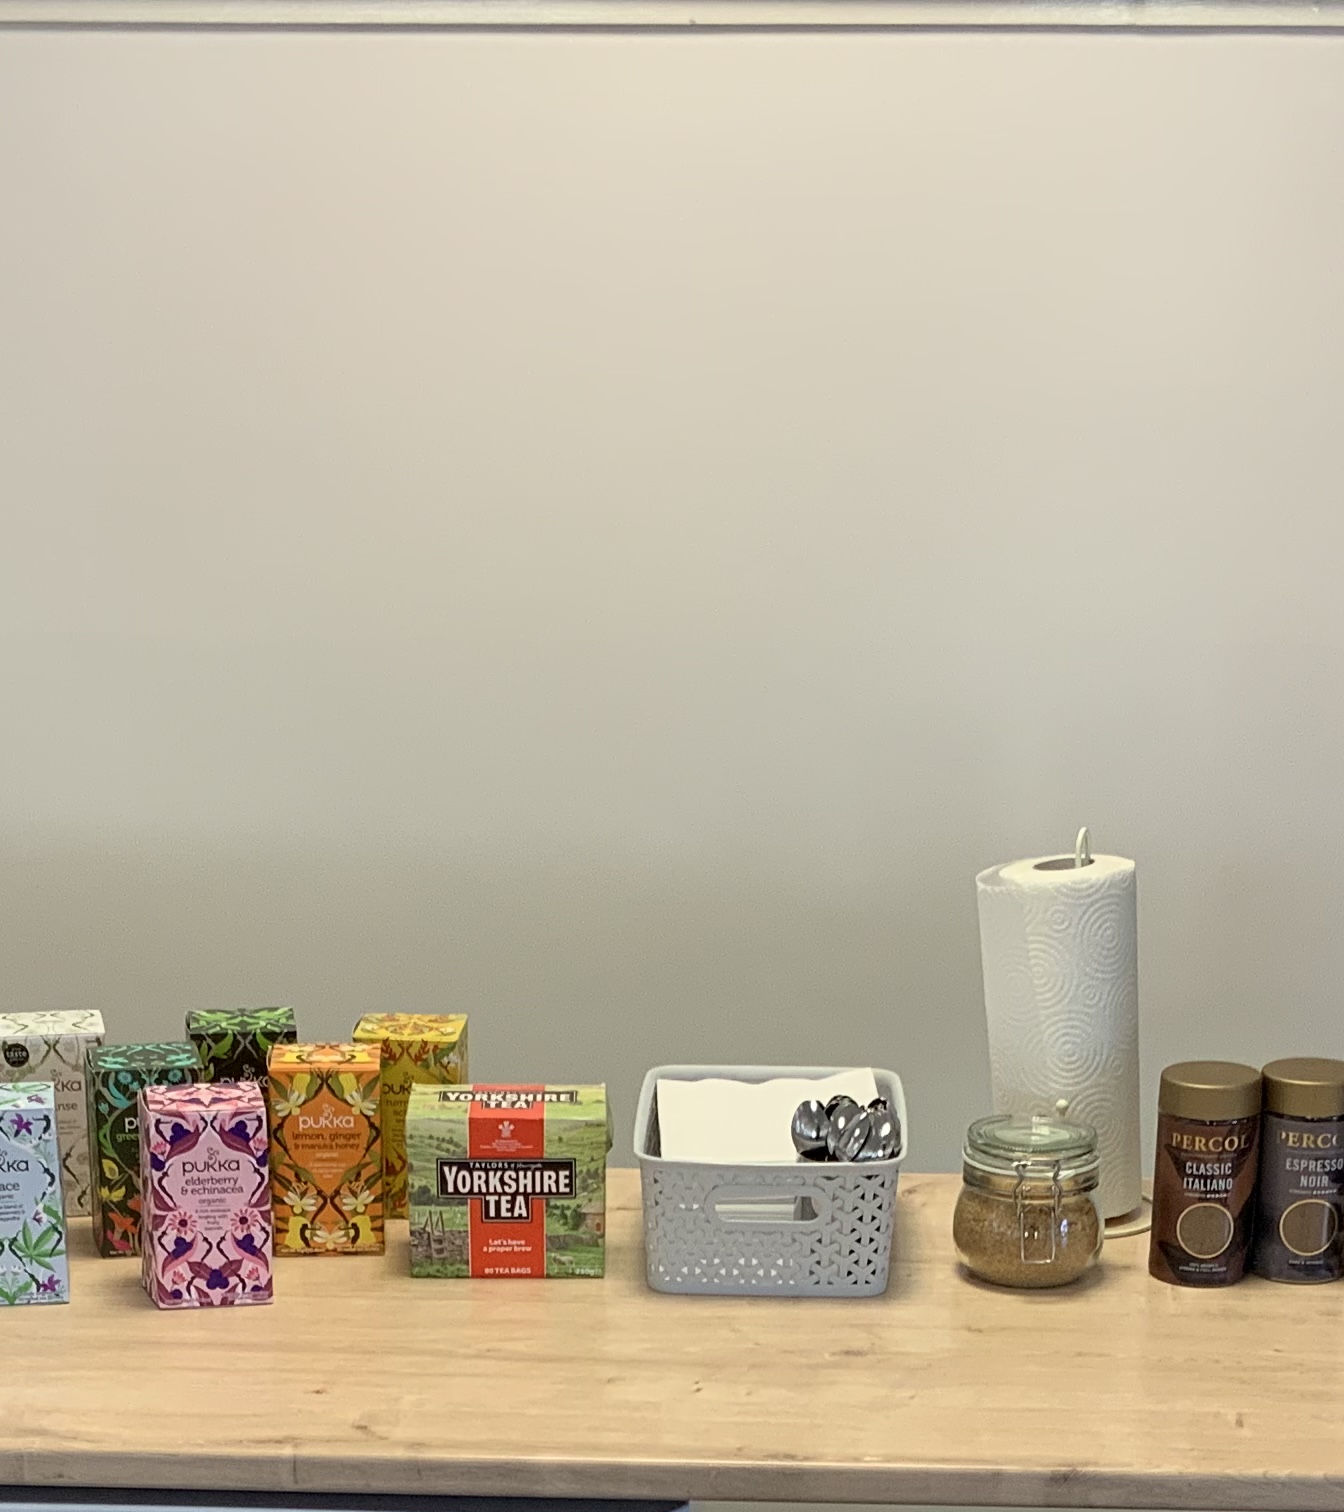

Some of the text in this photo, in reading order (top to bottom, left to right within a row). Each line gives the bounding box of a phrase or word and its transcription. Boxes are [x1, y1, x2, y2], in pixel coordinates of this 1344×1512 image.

[446, 1092, 571, 1102] YORKSHIRE
[487, 1100, 528, 1109] TEA
[299, 1110, 354, 1132] pukka
[116, 1132, 138, 1142] gree
[329, 1131, 361, 1142] ginger
[1172, 1132, 1249, 1152] PERCOL
[335, 1142, 360, 1151] honey
[182, 1153, 240, 1177] pukka
[1185, 1161, 1232, 1175] CLASSIC
[1285, 1158, 1344, 1172] ESPRESSO
[184, 1176, 239, 1187] elderberry
[442, 1165, 570, 1193] YORKSHIRE
[1183, 1177, 1233, 1191] ITALIANO
[1300, 1175, 1329, 1187] NOIR
[180, 1186, 244, 1195] & echinacea
[486, 1195, 527, 1217] TEA
